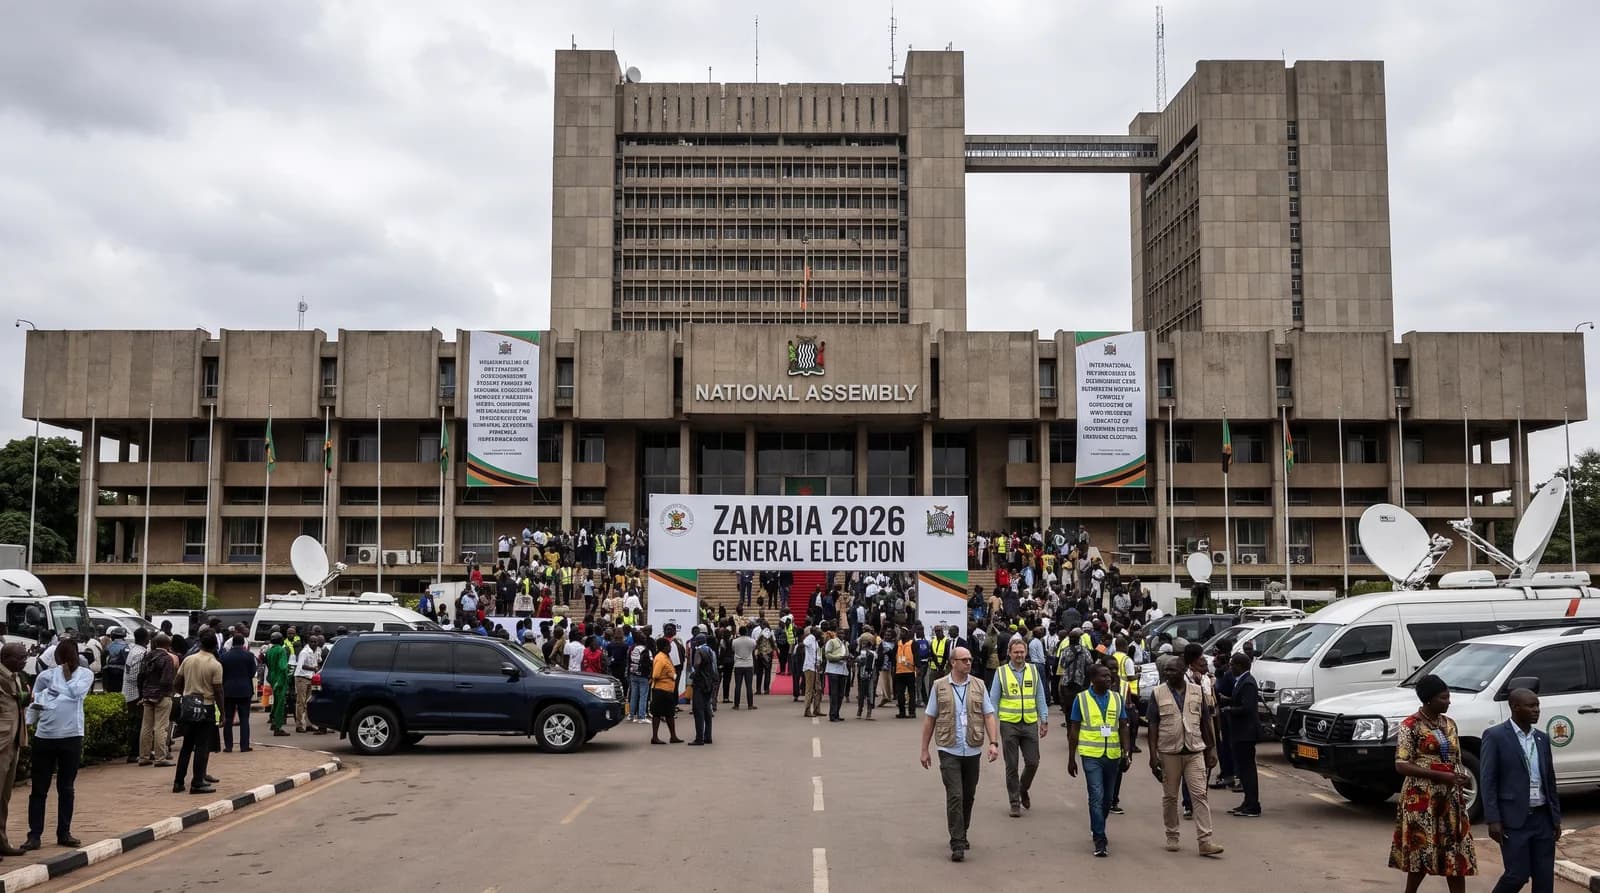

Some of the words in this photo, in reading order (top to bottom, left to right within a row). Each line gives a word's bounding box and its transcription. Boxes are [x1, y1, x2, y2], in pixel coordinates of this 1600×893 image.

[695, 384, 800, 401] NATIONAL
[805, 384, 918, 401] ASSEMBLY
[713, 505, 823, 536] ZAMBIA
[831, 505, 905, 536] 2026
[712, 540, 804, 563] GENERAL
[810, 540, 905, 563] ELECTION
